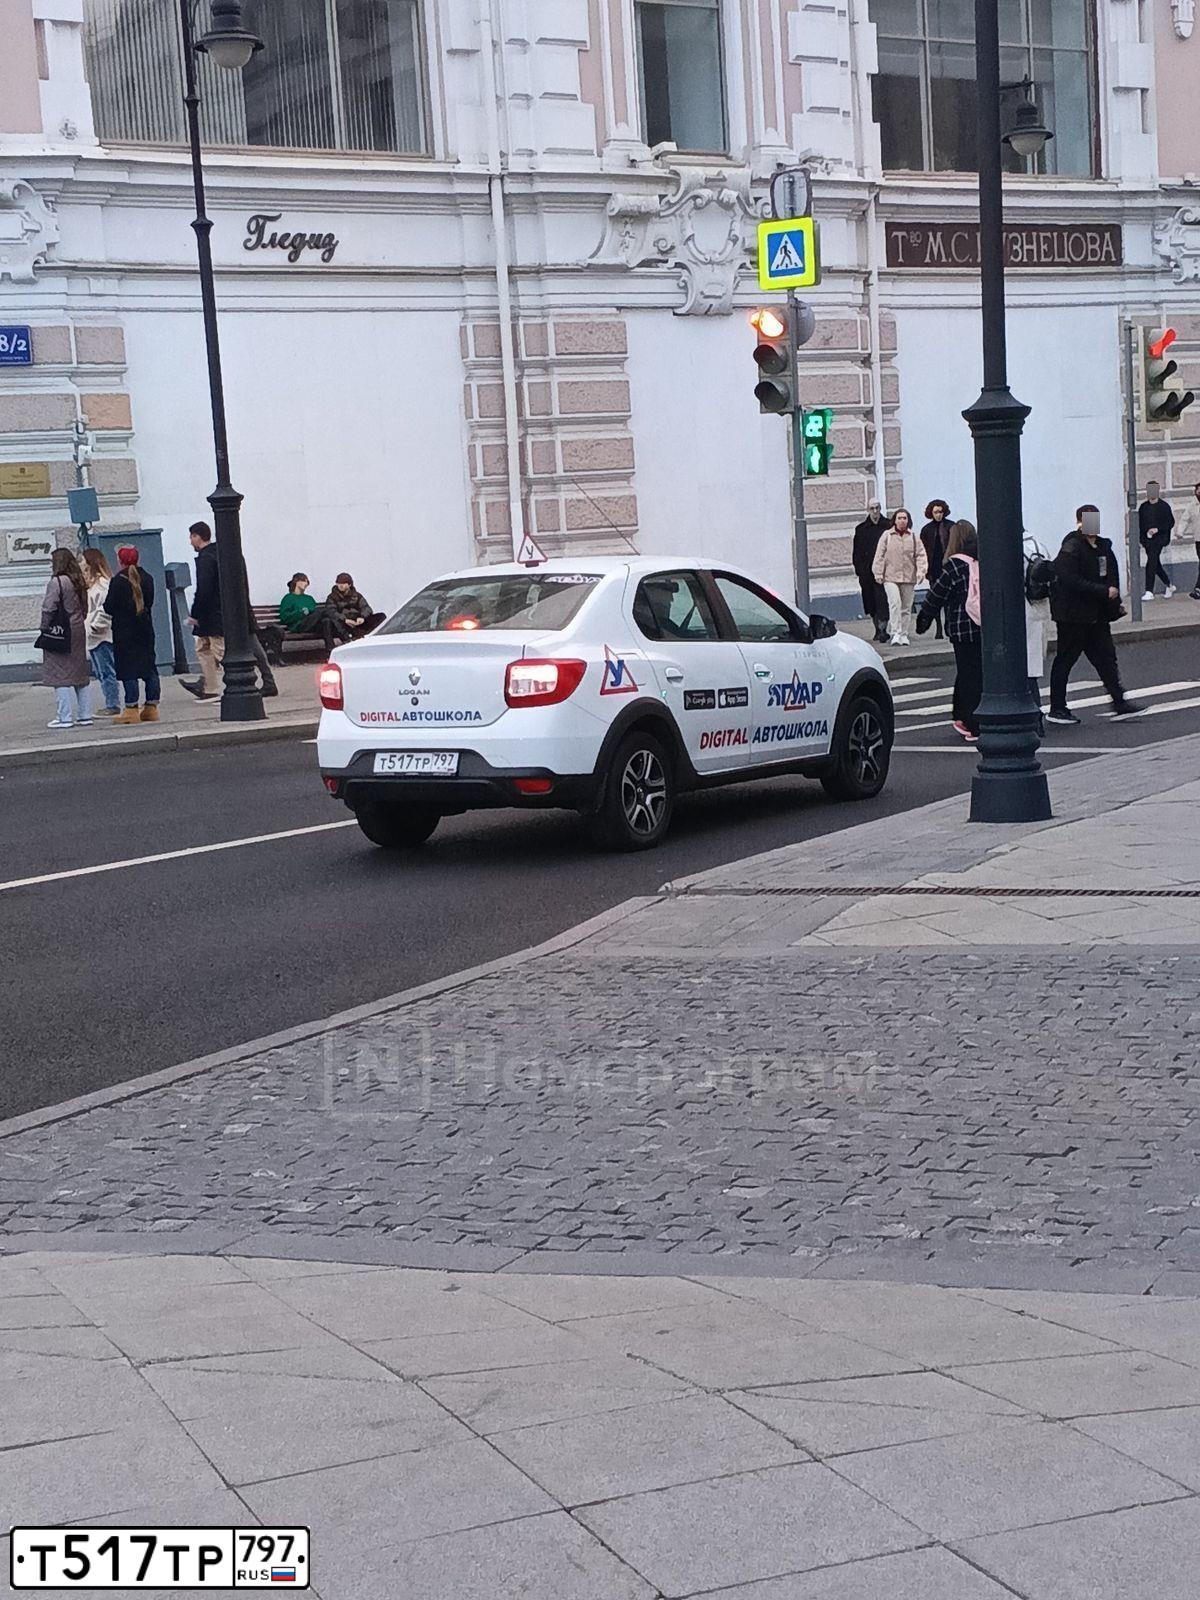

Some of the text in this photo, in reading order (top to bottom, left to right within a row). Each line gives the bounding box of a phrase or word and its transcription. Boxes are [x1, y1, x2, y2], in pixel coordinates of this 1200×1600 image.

[977, 232, 1117, 263] ЗНЕЦОВА
[360, 710, 482, 722] DIGITAL АВТОШКОЛА
[700, 720, 828, 749] DIGITAL АВТОШКОЛА
